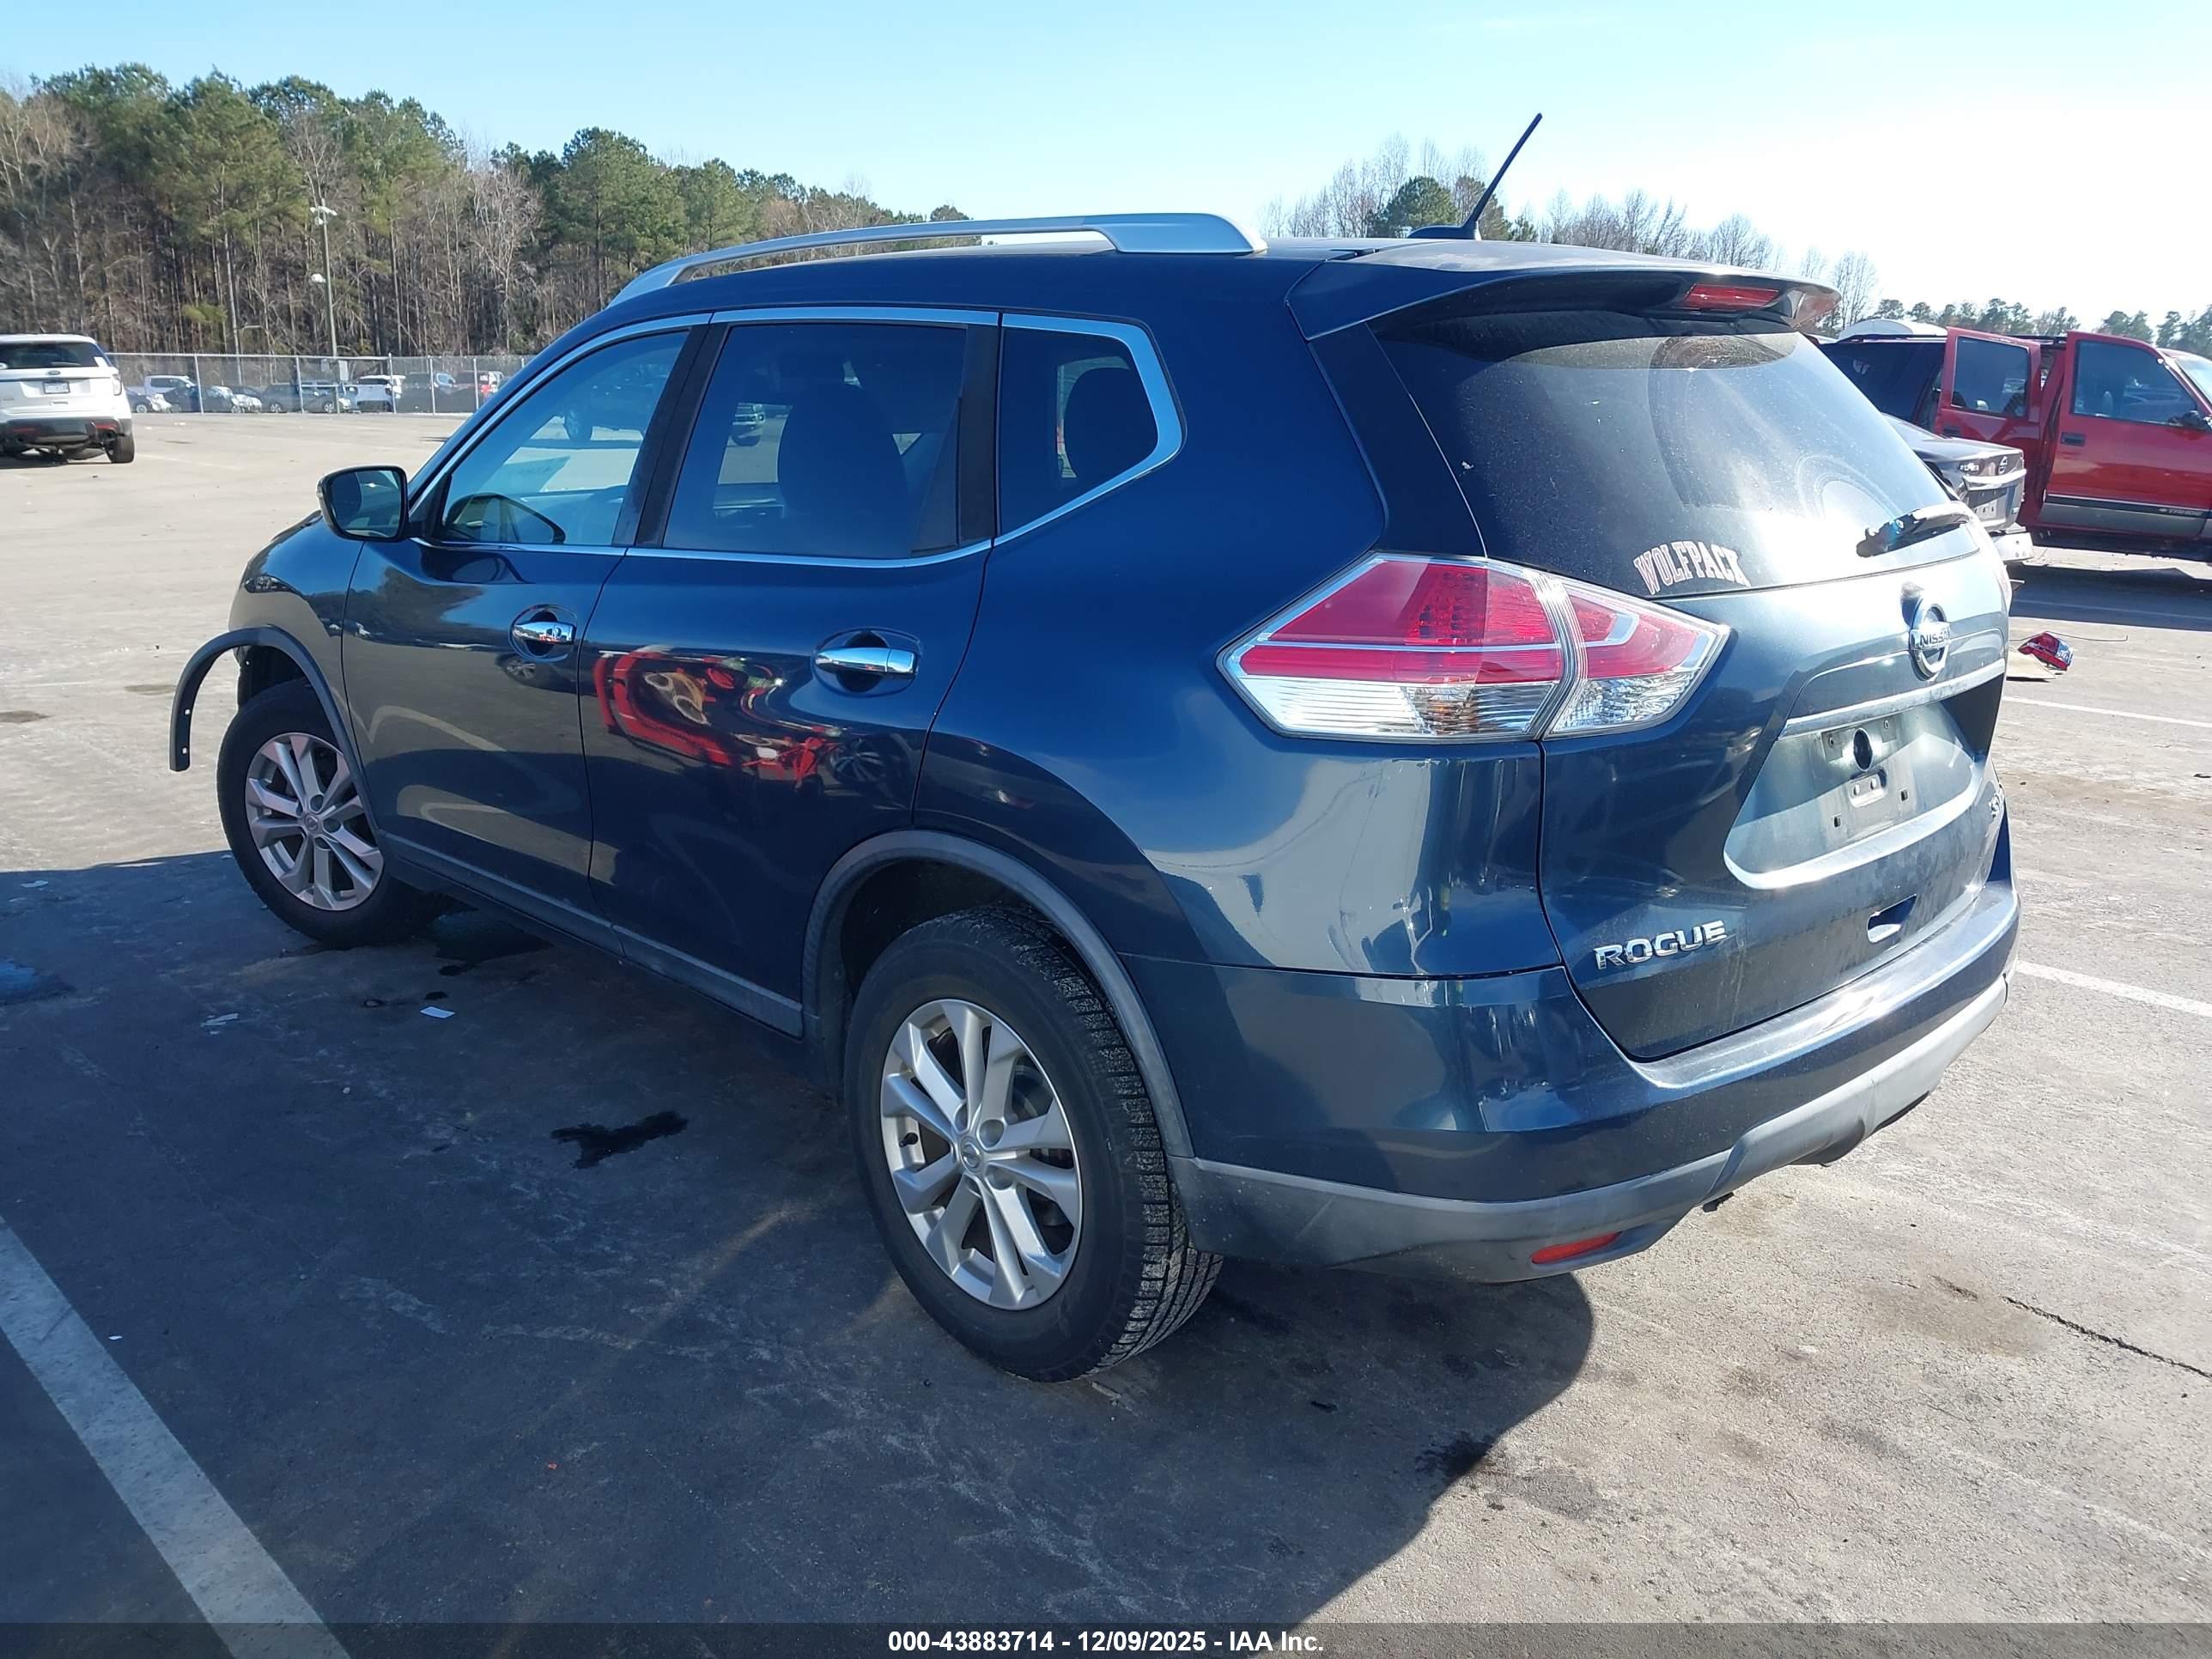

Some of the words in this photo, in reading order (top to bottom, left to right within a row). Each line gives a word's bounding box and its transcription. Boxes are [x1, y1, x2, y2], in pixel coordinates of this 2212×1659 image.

[1633, 540, 1752, 595] WOLFPACK
[1919, 626, 1951, 647] NISSAN
[1593, 920, 1728, 970] ROGUE
